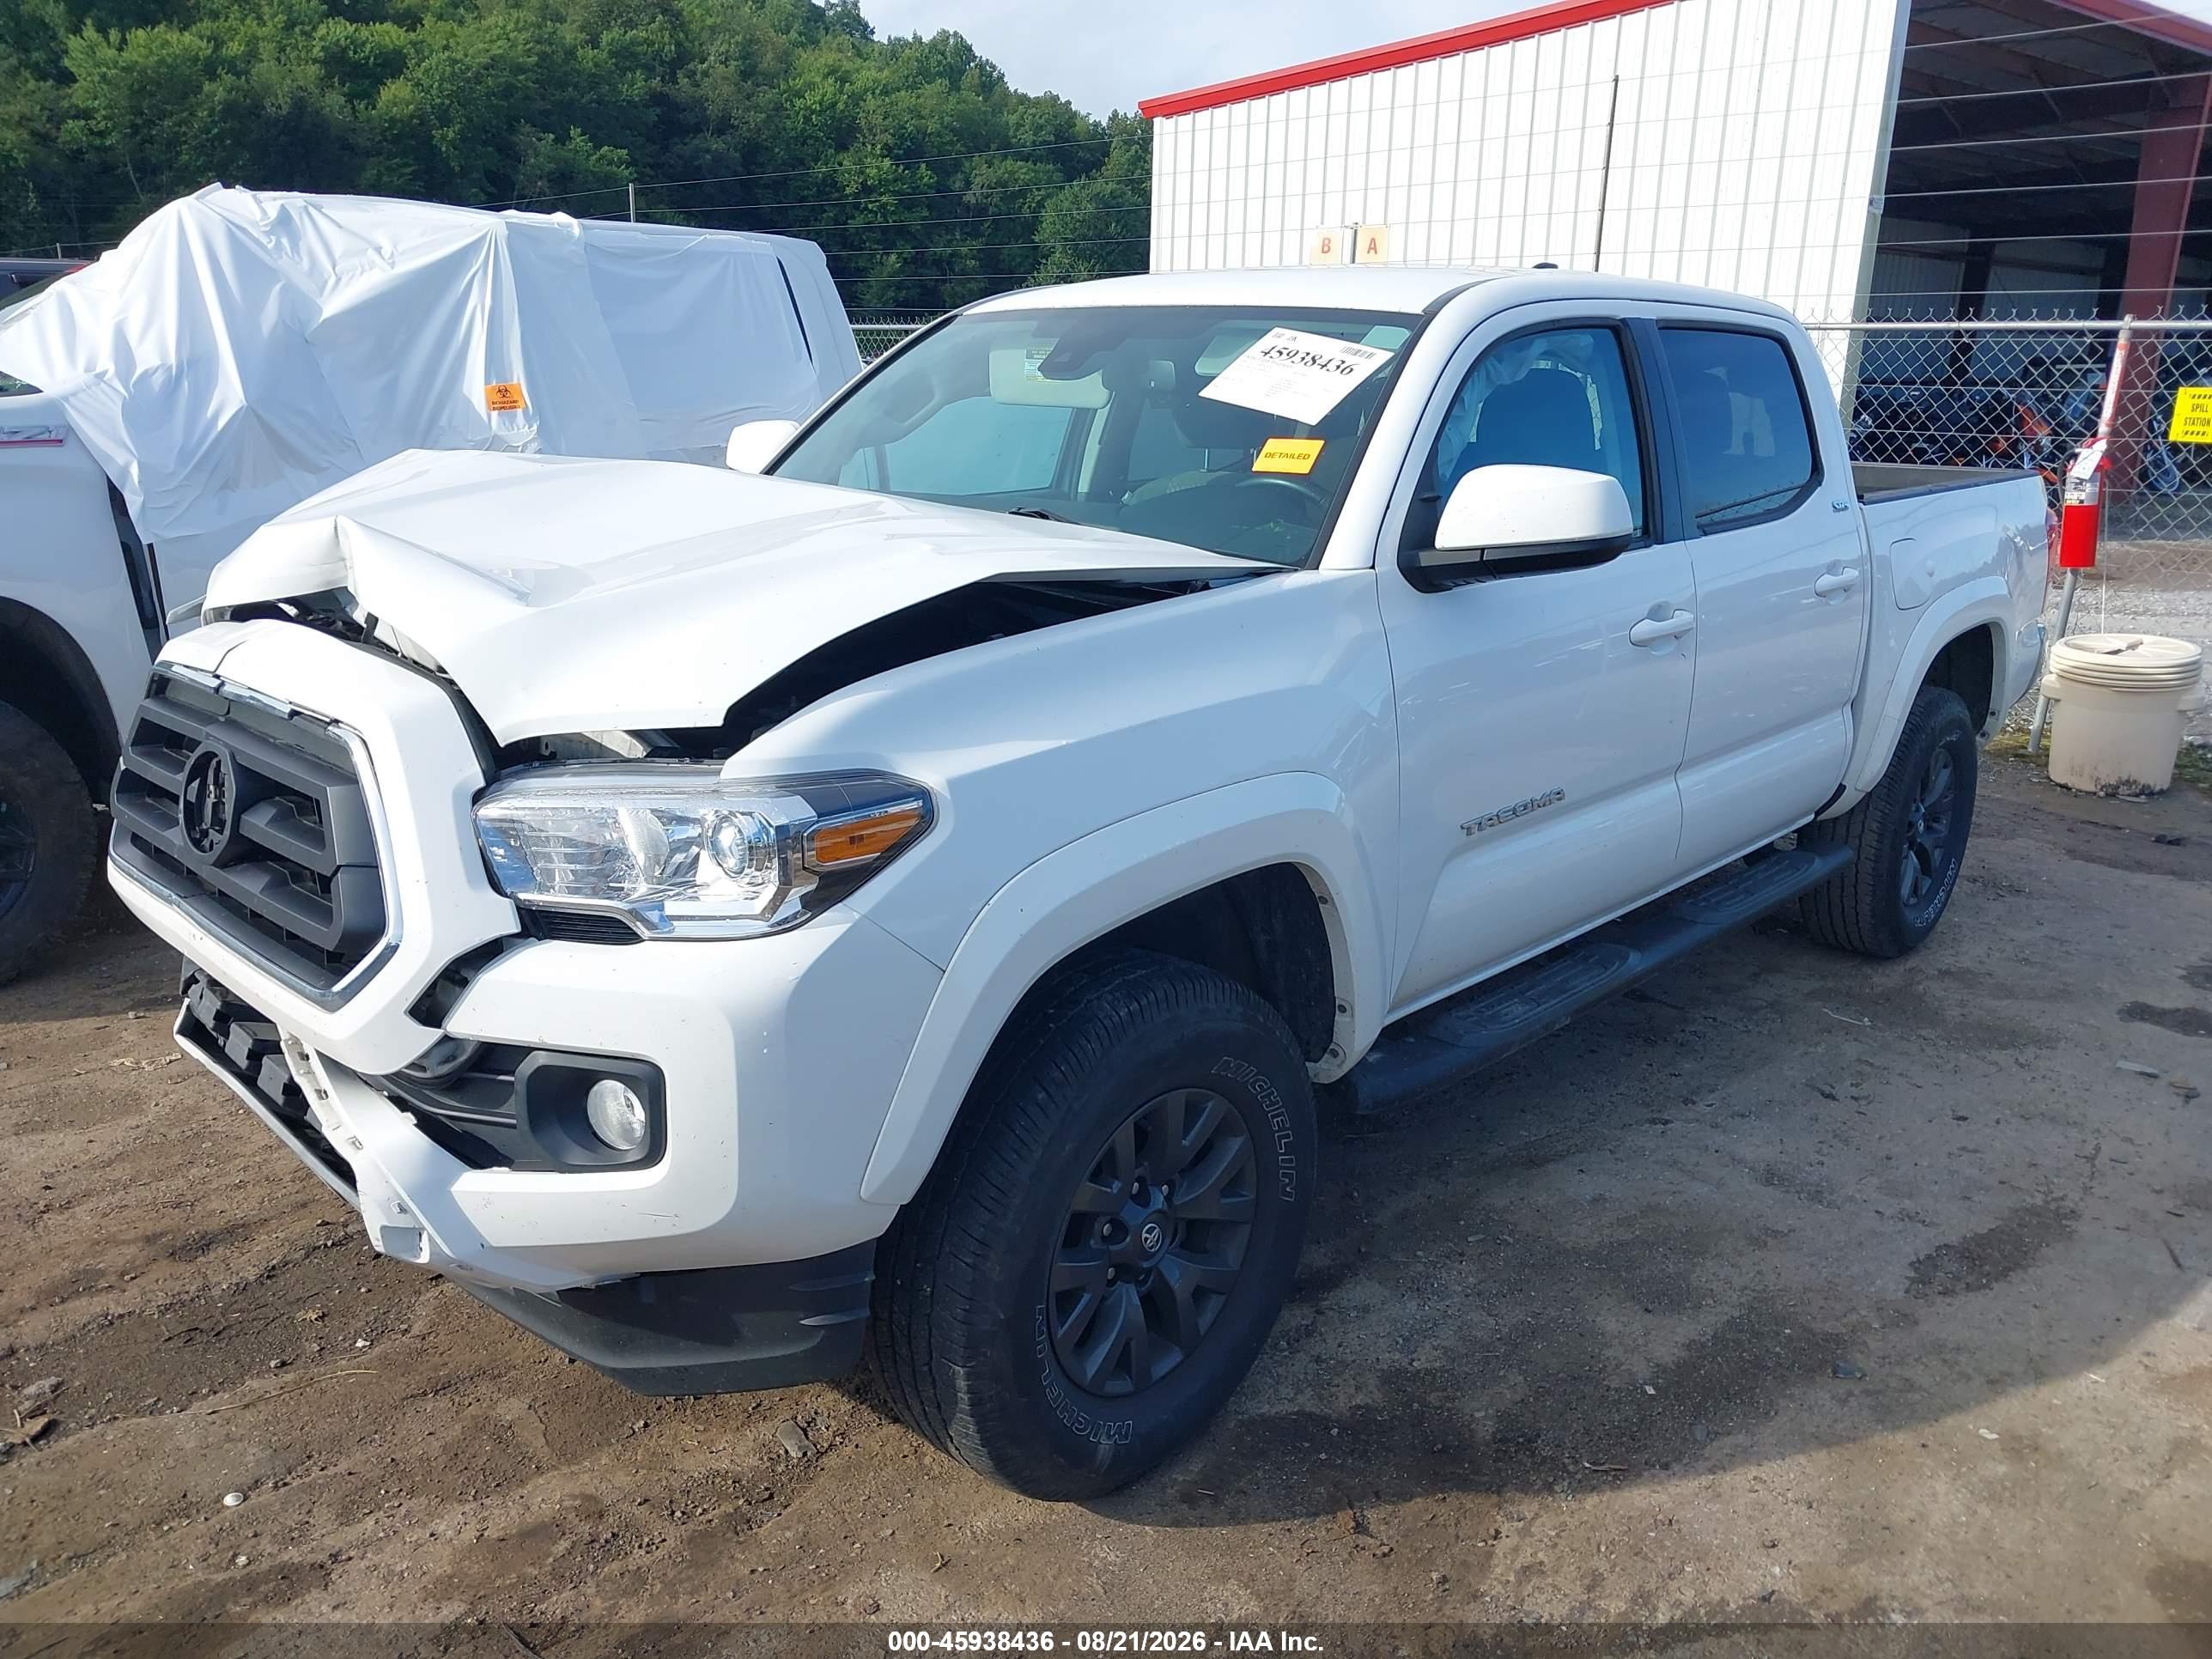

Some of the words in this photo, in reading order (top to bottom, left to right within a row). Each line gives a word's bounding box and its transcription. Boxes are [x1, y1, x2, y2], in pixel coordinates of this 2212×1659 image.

[1321, 237, 1332, 254] B
[1366, 237, 1378, 255] A
[1259, 344, 1361, 376] 45938436
[2191, 403, 2209, 413] SPILL
[2183, 416, 2211, 427] STATION
[1263, 452, 1311, 461] DETAILED
[1460, 787, 1566, 836] TACOMA
[1211, 1056, 1297, 1202] MICHELIN
[1035, 1304, 1134, 1444] MICHELIN
